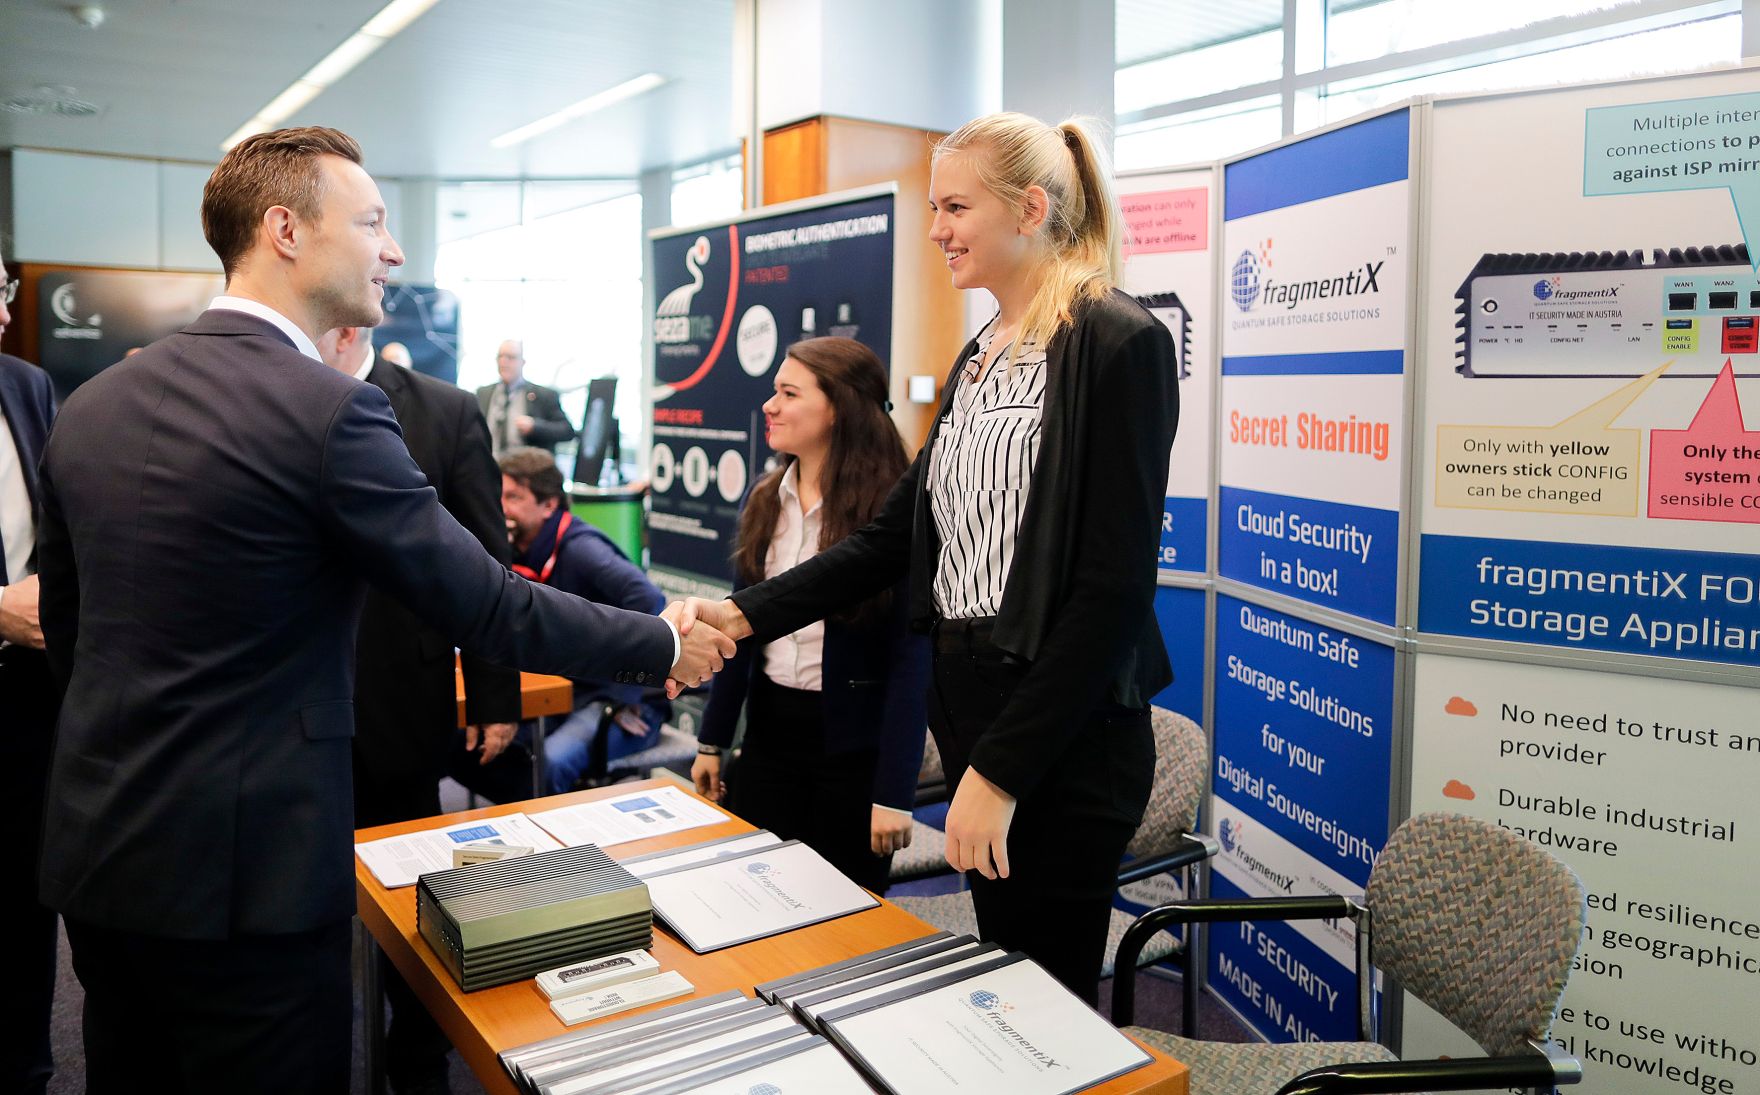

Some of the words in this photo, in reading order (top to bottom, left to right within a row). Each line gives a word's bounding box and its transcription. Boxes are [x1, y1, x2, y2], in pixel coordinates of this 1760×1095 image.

[1633, 112, 1709, 132] Multiple
[1606, 138, 1716, 158] connections
[1722, 135, 1742, 148] to
[1613, 164, 1677, 183] against
[1684, 161, 1713, 176] ISP
[1174, 197, 1196, 210] only
[1145, 236, 1160, 244] are
[1163, 232, 1197, 243] offline
[1263, 261, 1384, 310] fragmentiX
[1554, 287, 1619, 300] fragmentiX
[1232, 318, 1265, 331] QUANTUM
[1267, 317, 1285, 328] SAFE
[1287, 312, 1324, 325] STORAGE
[1326, 308, 1380, 322] SOLUTIONS
[1536, 311, 1565, 320] SECURITY
[1565, 310, 1585, 319] MADE
[1586, 310, 1594, 319] IN
[1594, 309, 1623, 319] AUSTRIA
[1231, 409, 1288, 448] Secret
[1297, 412, 1390, 461] Sharing
[1463, 439, 1501, 456] Only
[1507, 440, 1544, 454] with
[1550, 441, 1610, 458] yellow
[1683, 444, 1727, 462] Only
[1445, 463, 1507, 476] owners
[1513, 463, 1552, 477] stick
[1558, 464, 1628, 480] CONFIG
[1467, 485, 1495, 497] can
[1501, 484, 1522, 499] be
[1527, 486, 1602, 504] changed
[1684, 470, 1750, 486] system
[1162, 512, 1174, 533] R
[1660, 492, 1734, 509] sensible
[1238, 505, 1285, 539] Cloud
[1289, 514, 1372, 564] Security
[1261, 551, 1276, 580] in
[1280, 561, 1292, 585] a
[1297, 558, 1338, 596] box!
[1477, 557, 1688, 600] fragmentiX
[1700, 574, 1760, 604] FO
[1240, 606, 1314, 652] Quantum
[1318, 631, 1359, 669] Safe
[1470, 599, 1609, 642] Storage
[1227, 655, 1286, 702] Storage
[1289, 680, 1373, 738] Solutions
[1261, 723, 1285, 755] for
[1287, 742, 1325, 776] your
[1501, 703, 1535, 724] No
[1545, 714, 1607, 733] need
[1616, 718, 1643, 737] to
[1653, 722, 1719, 747] trust
[1729, 735, 1760, 753] an
[1500, 739, 1607, 766] provider
[1218, 755, 1263, 801] Digital
[1267, 783, 1380, 866] Souvereignty
[1499, 788, 1596, 820] Durable
[1606, 804, 1735, 842] industrial
[1236, 844, 1294, 895] fragmentiX
[1586, 893, 1617, 912] ed
[1627, 900, 1760, 939] resilience
[1240, 920, 1255, 945] IT
[1257, 931, 1339, 1012] SECURITY
[1572, 954, 1623, 979] sion
[1602, 929, 1760, 974] geographic
[1219, 952, 1262, 1008] MADE
[1265, 993, 1282, 1026] IN
[986, 1011, 1061, 1069] fragmentiX
[1583, 1010, 1610, 1031] to
[1620, 1021, 1665, 1044] use
[1675, 1033, 1757, 1066] witho
[1584, 1040, 1734, 1095] knowledge
